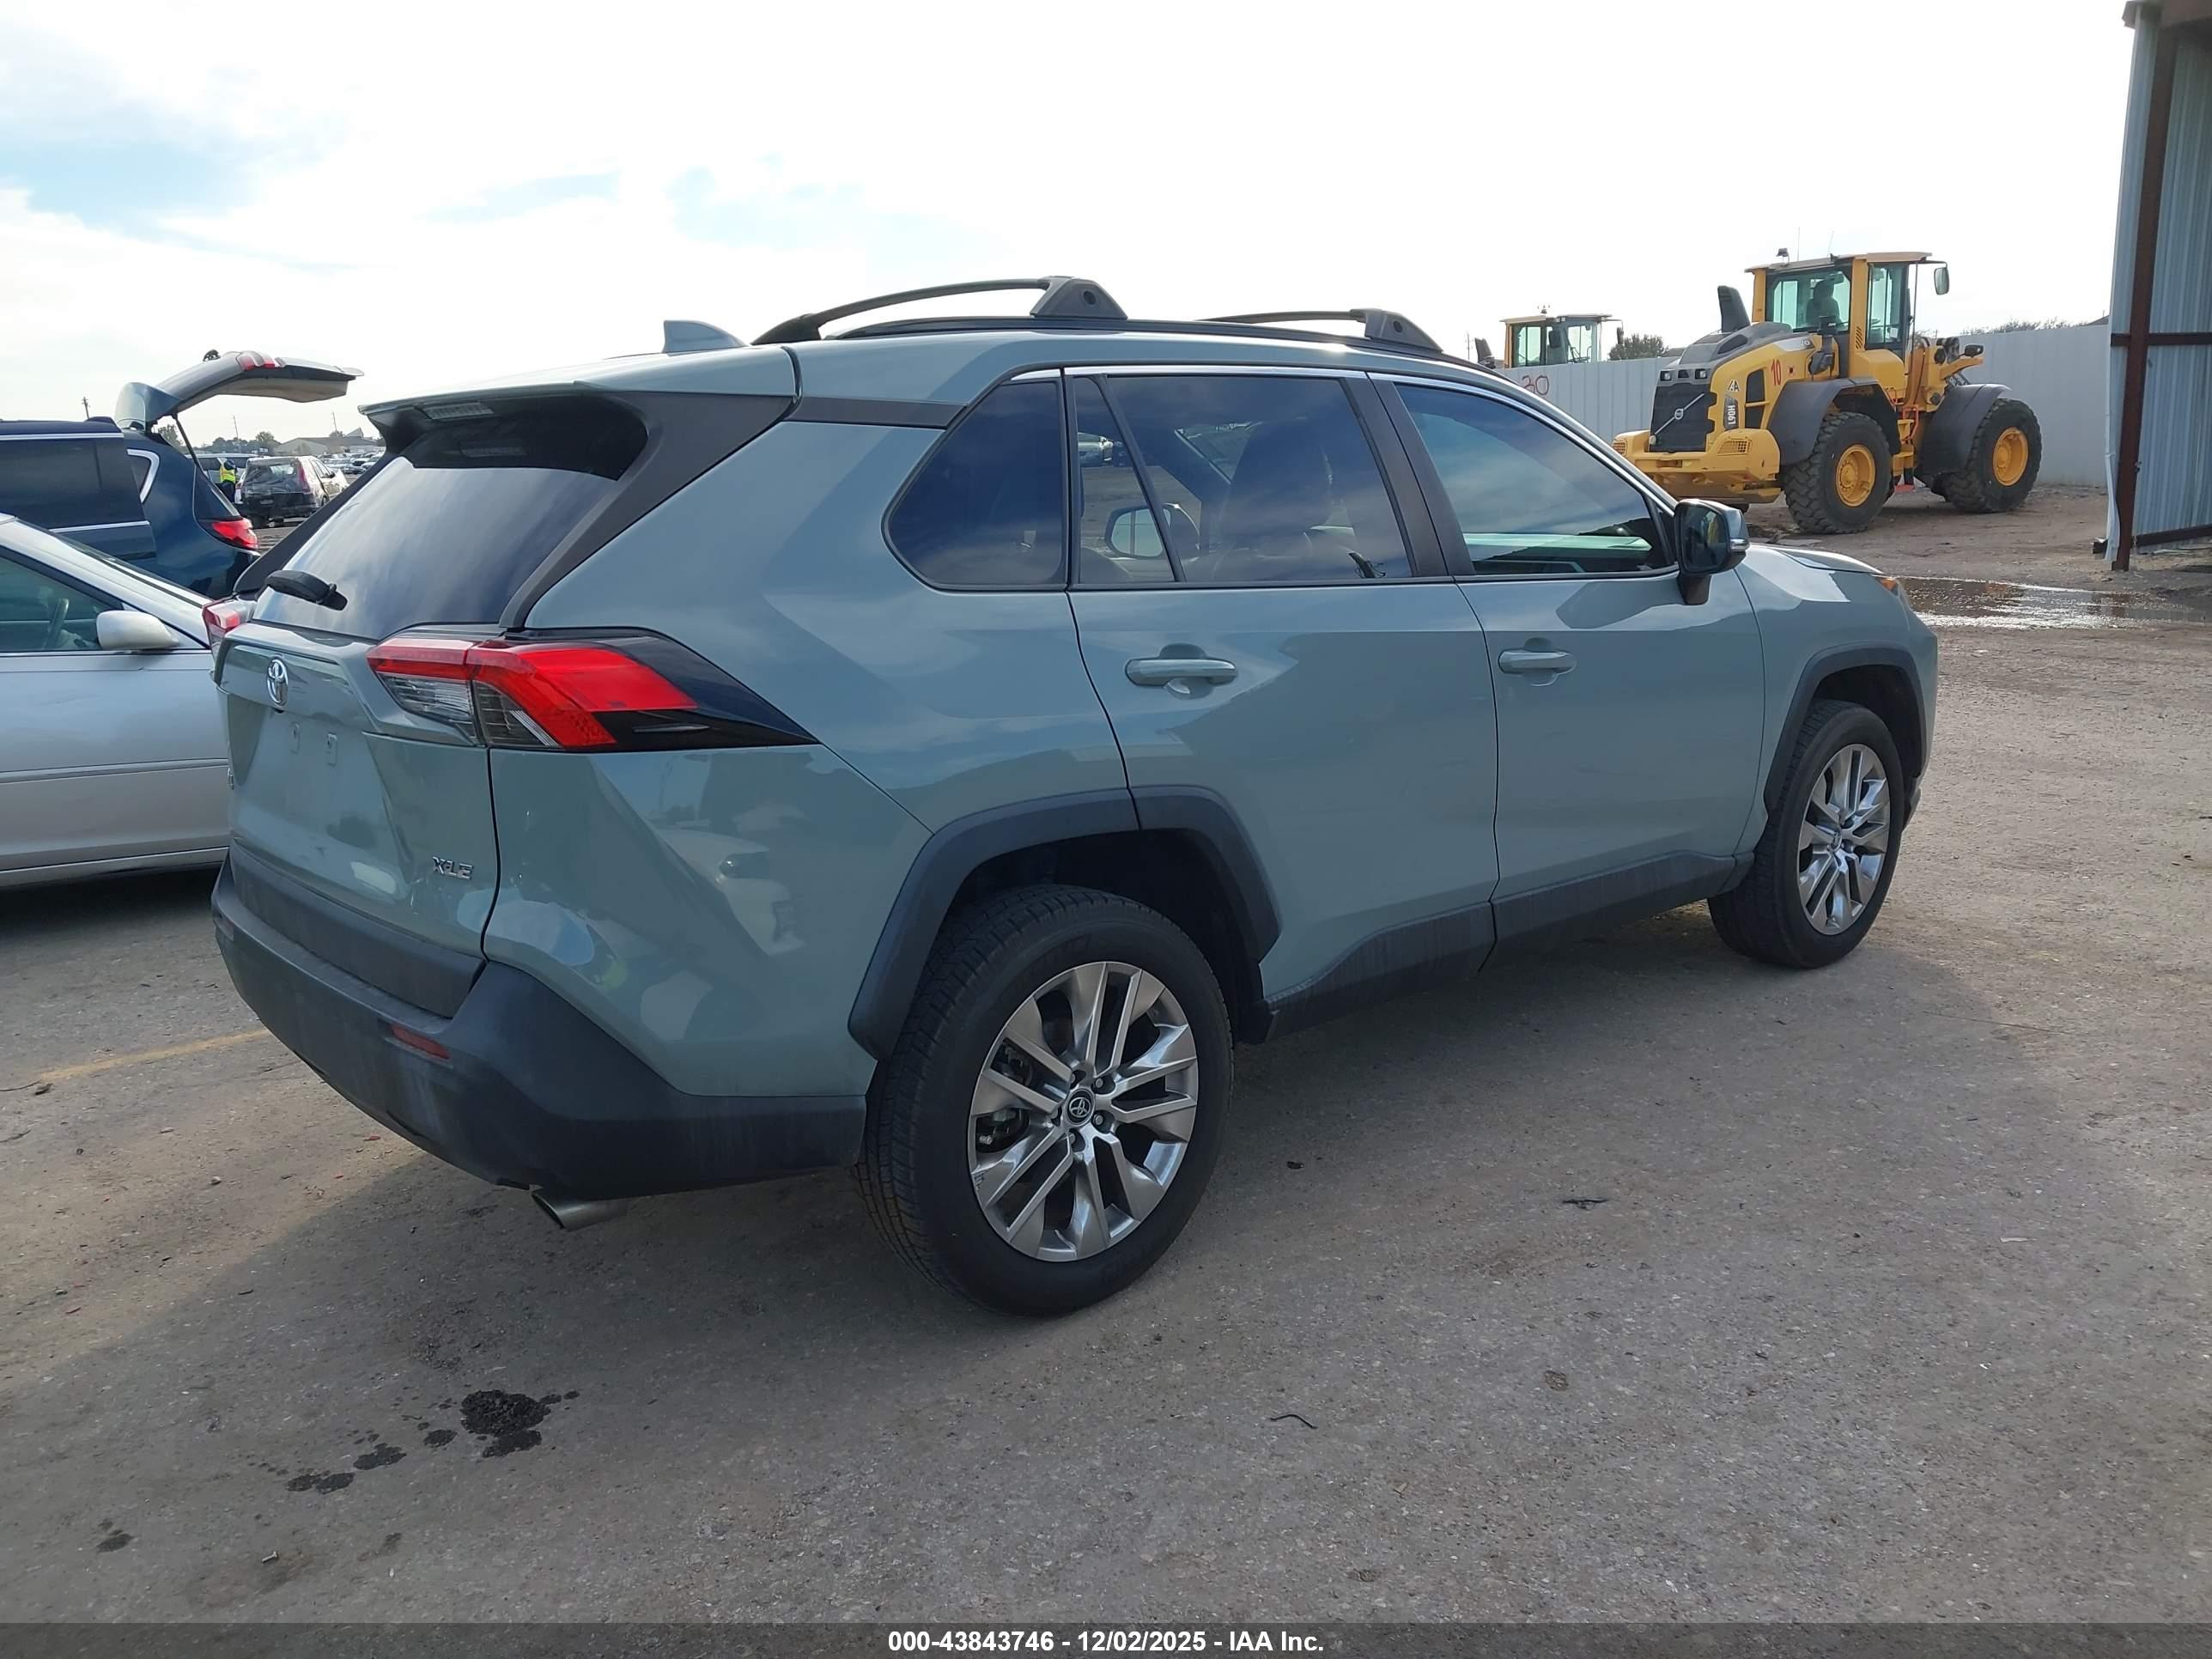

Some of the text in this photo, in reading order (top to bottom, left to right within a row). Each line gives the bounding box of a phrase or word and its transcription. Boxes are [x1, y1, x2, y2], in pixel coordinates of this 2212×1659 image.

[1771, 358, 1782, 386] 10
[1727, 404, 1736, 425] L90H
[432, 856, 474, 880] XLE
